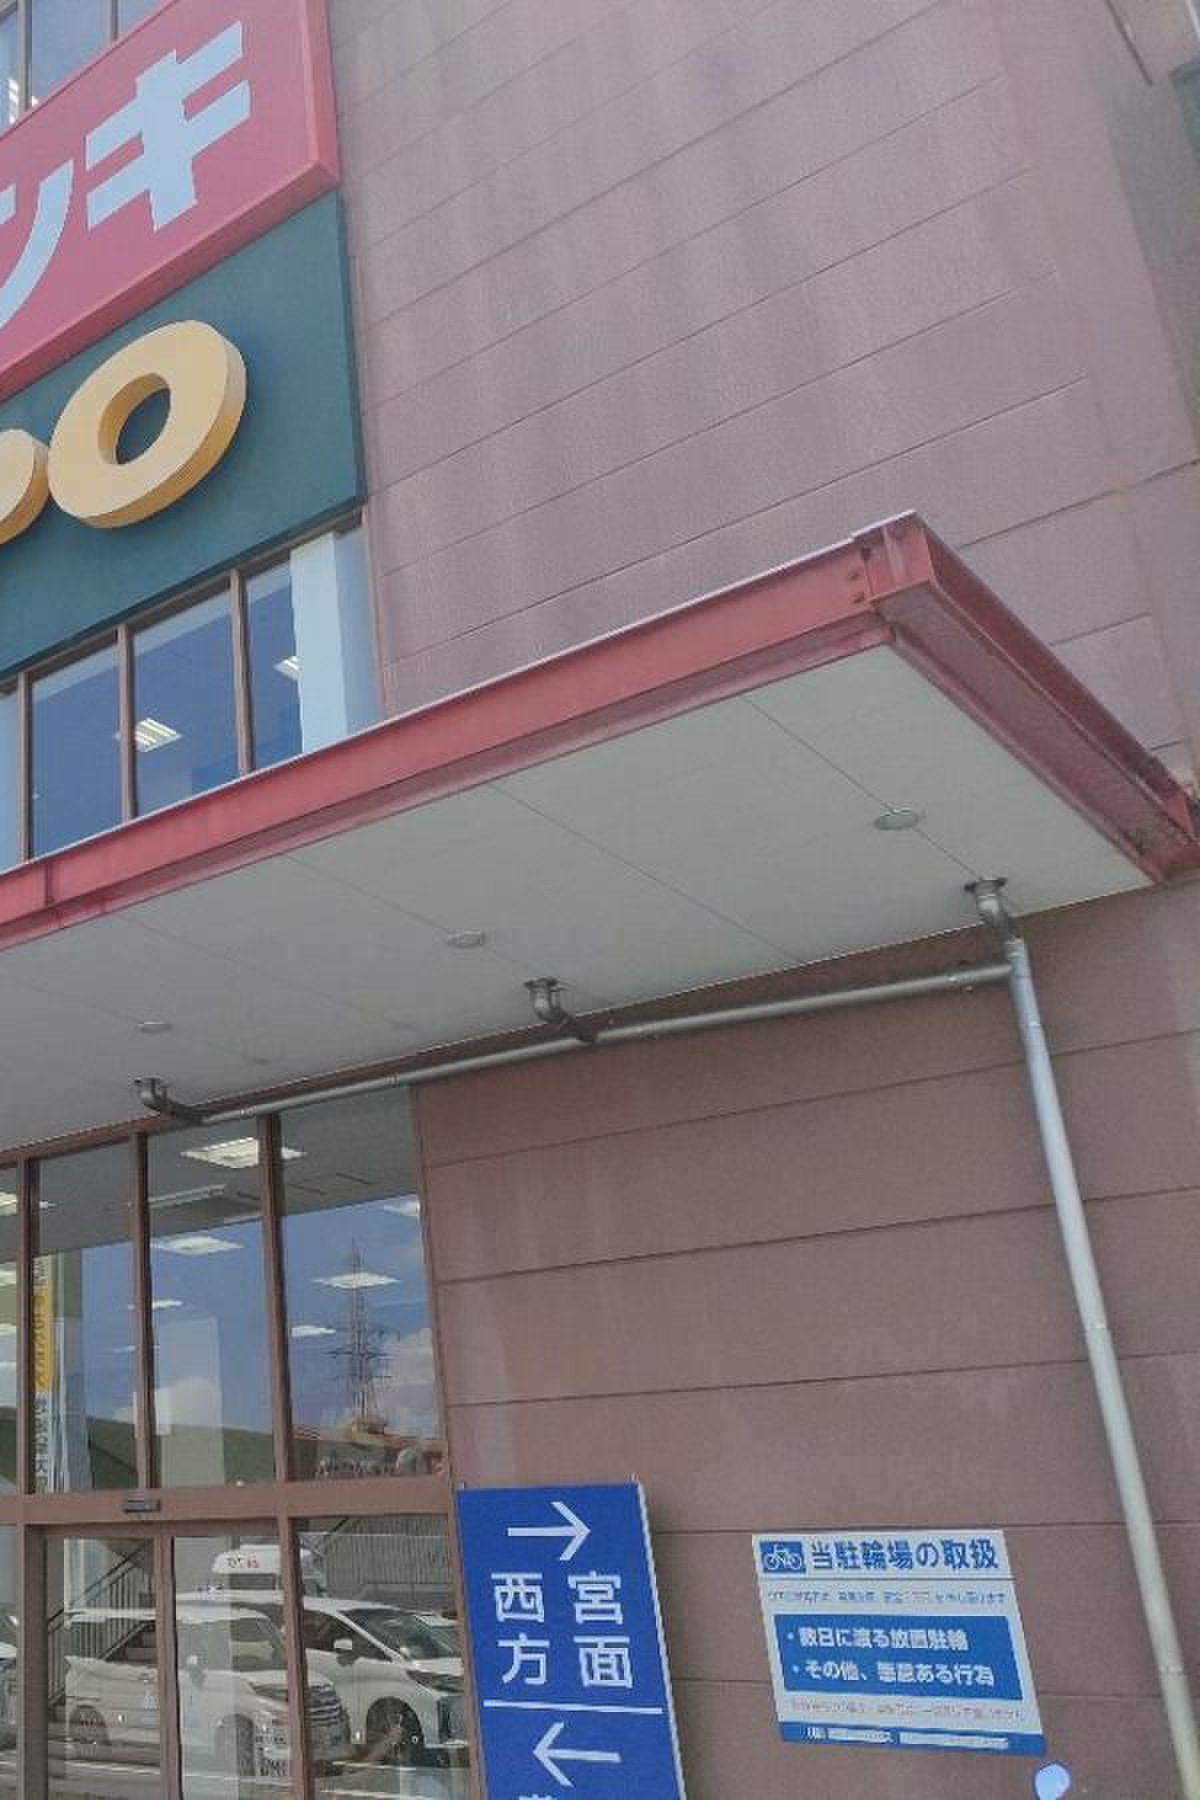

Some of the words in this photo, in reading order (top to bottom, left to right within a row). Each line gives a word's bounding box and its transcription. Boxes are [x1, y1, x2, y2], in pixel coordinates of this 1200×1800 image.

[811, 1538, 999, 1570] 当駐輪場の取扱
[491, 1571, 623, 1624] 西宮
[498, 1632, 634, 1689] 方面
